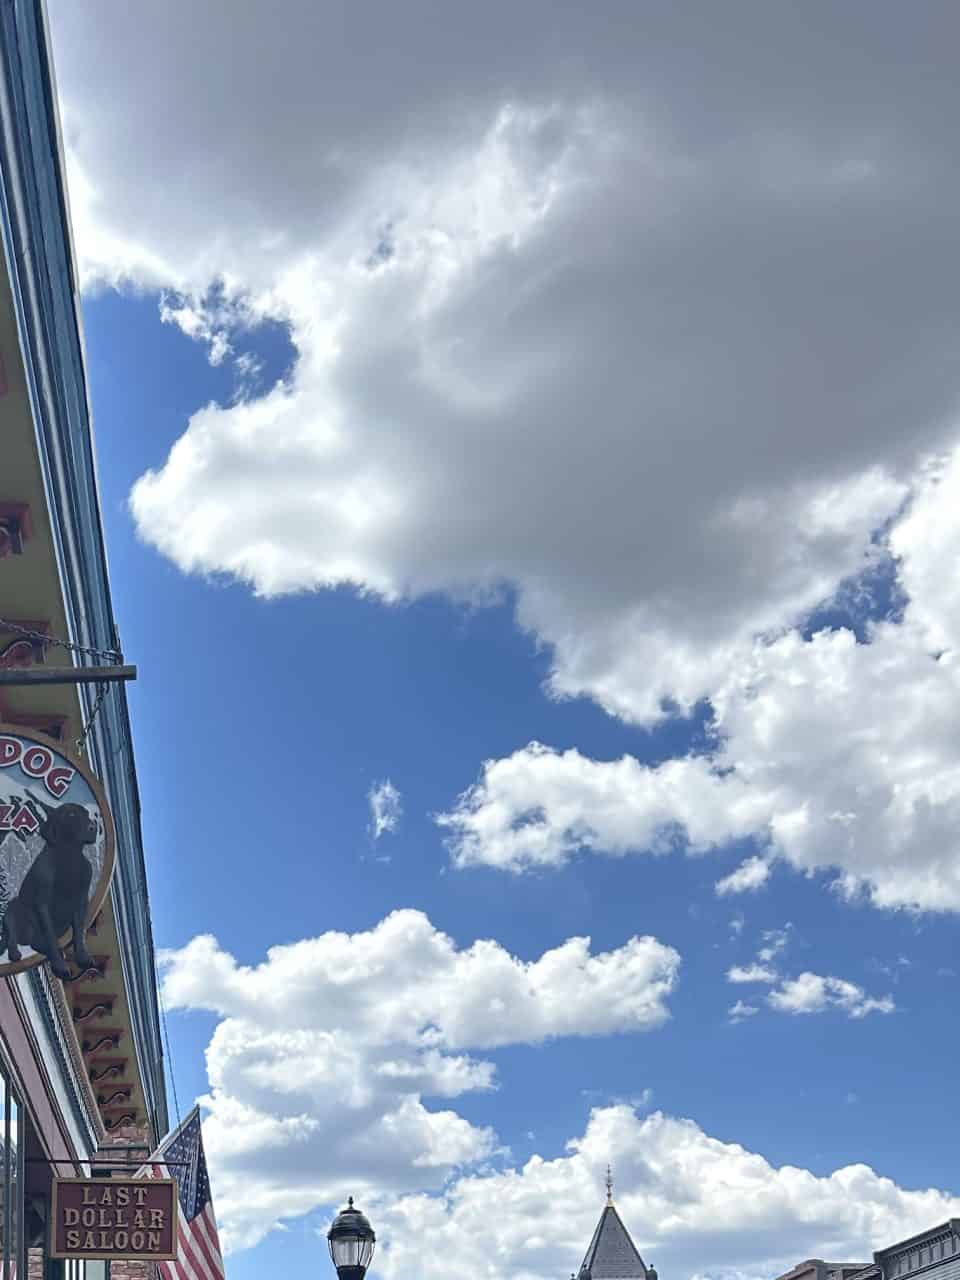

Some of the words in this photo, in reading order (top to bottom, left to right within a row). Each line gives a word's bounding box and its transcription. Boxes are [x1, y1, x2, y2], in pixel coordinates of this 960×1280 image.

[81, 1187, 148, 1206] LAST
[64, 1208, 164, 1229] DOLLAR
[67, 1231, 161, 1250] SALOON
